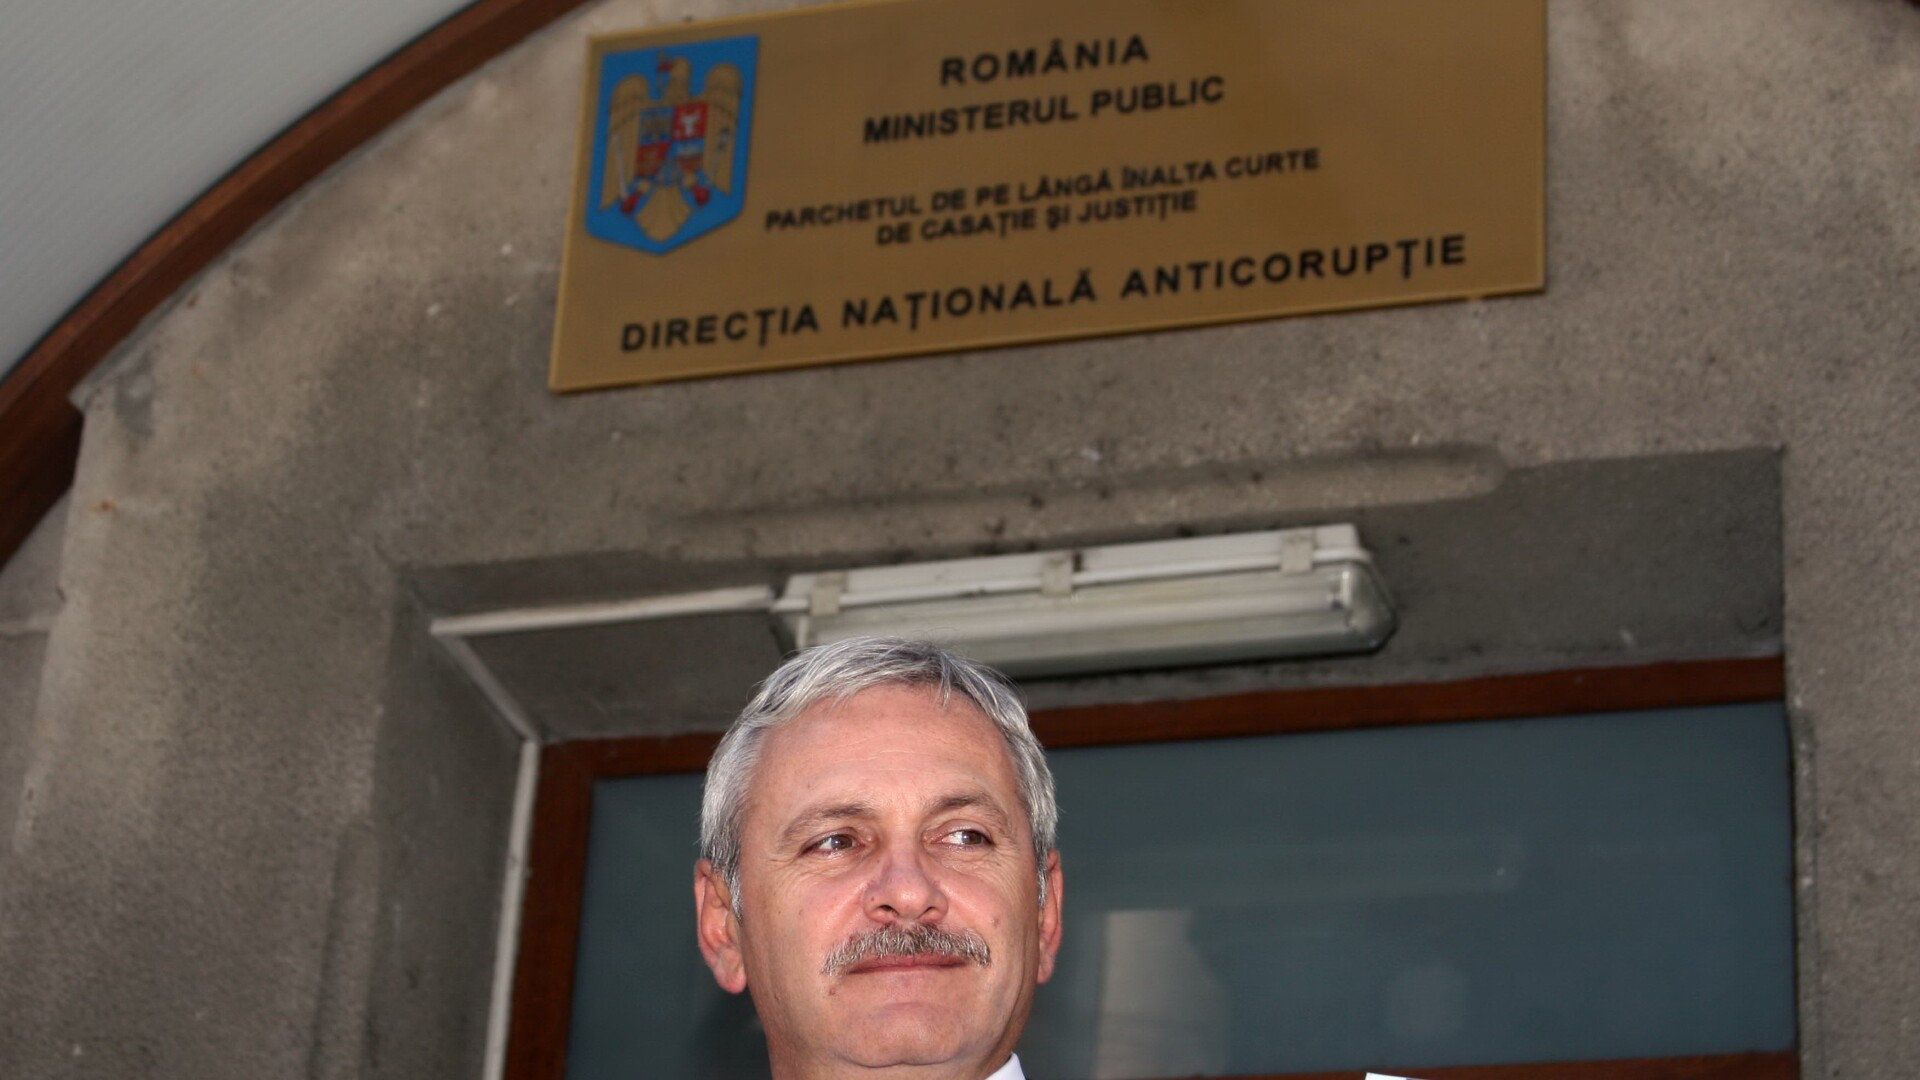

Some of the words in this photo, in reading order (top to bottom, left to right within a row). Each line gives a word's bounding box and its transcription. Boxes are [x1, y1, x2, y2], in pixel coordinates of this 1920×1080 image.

[940, 33, 1150, 87] ROMÂNIA
[863, 101, 1079, 144] MINISTERUL
[1090, 75, 1226, 118] PUBLIC
[765, 196, 923, 231] PARCHETUL
[931, 189, 967, 214] DE
[976, 183, 1010, 207] PE
[1120, 157, 1216, 192] ÎNALTA
[1224, 147, 1321, 180] CURTE
[875, 221, 912, 248] DE
